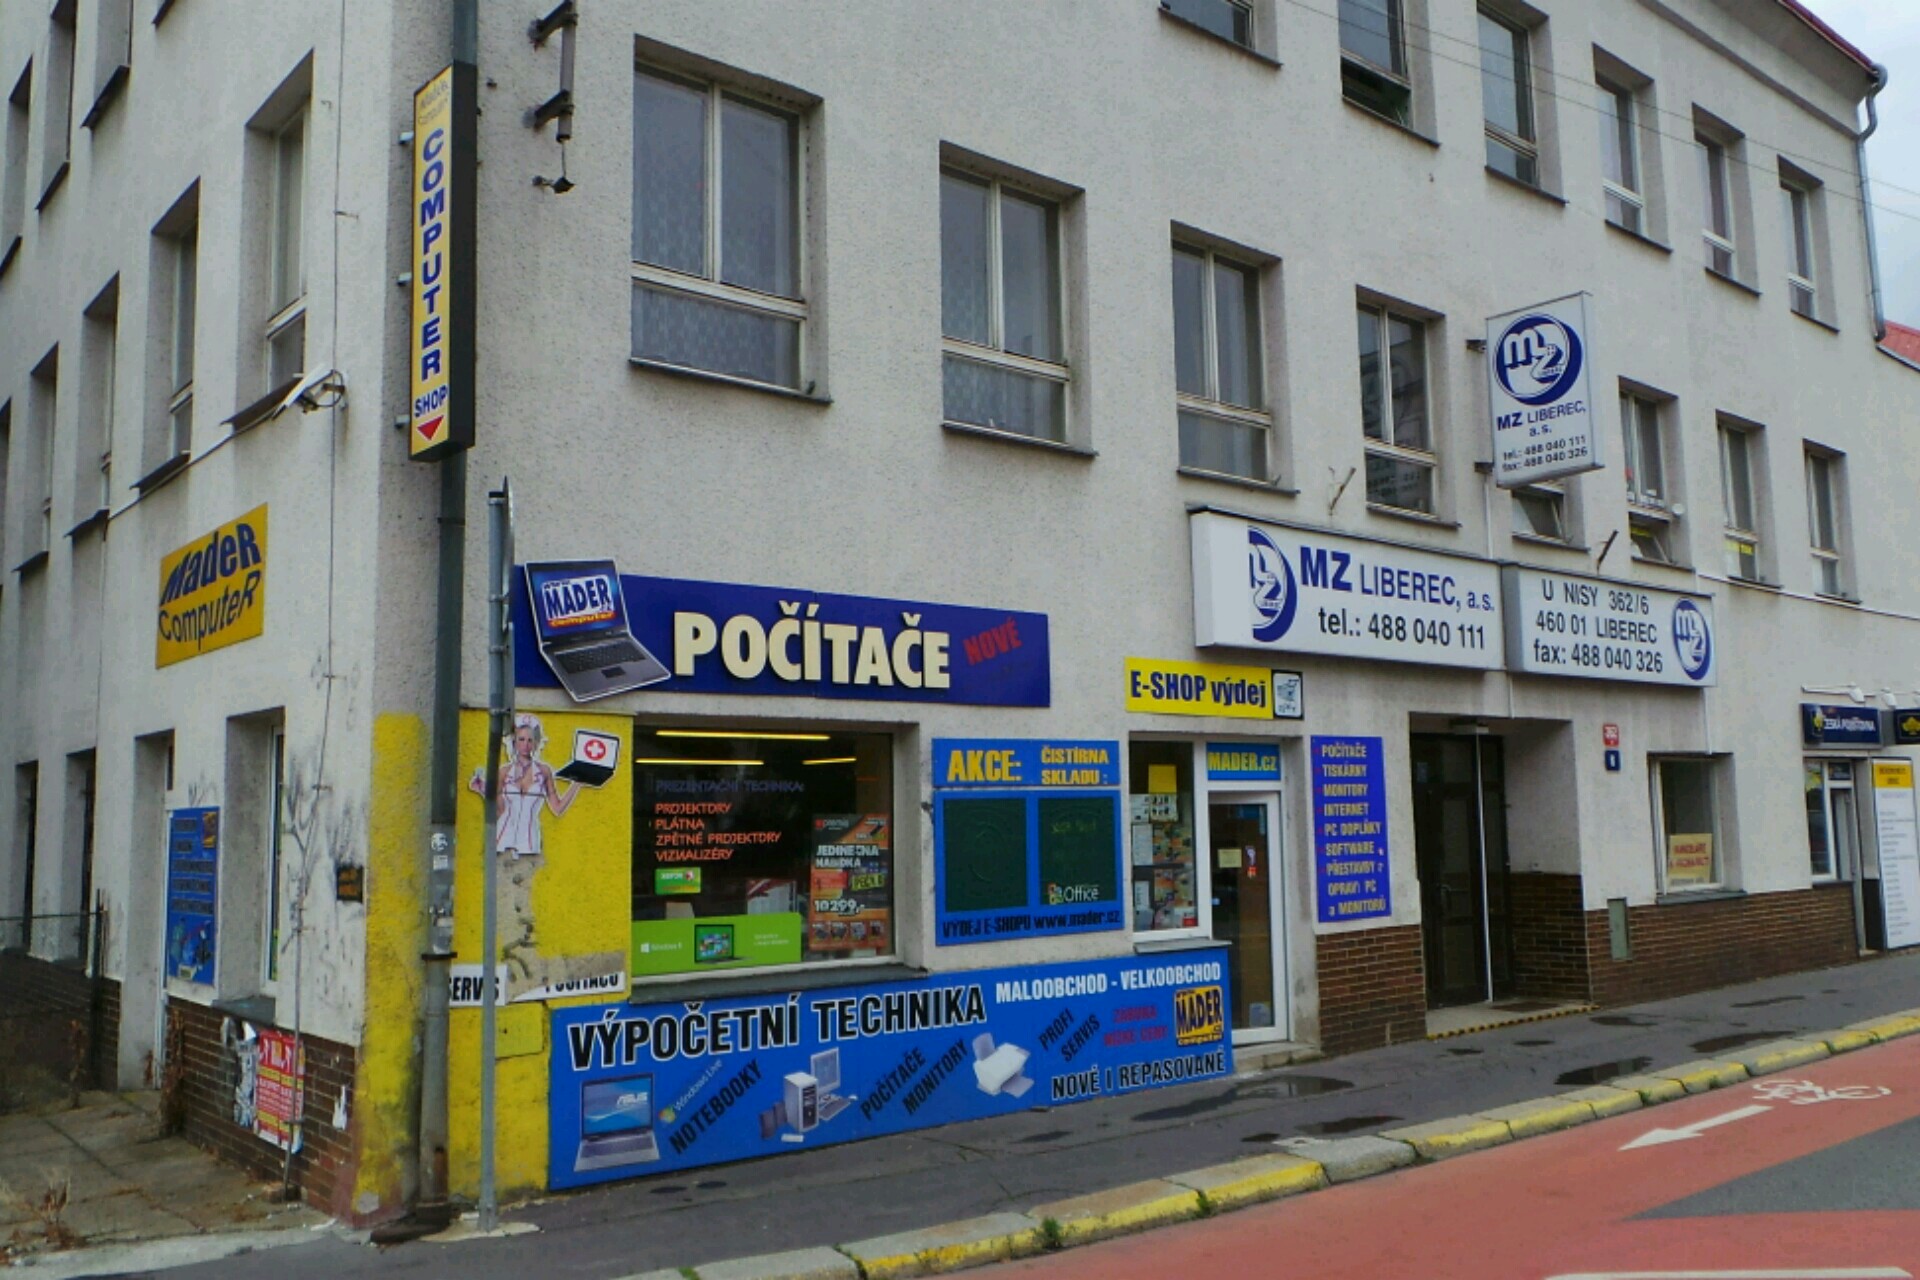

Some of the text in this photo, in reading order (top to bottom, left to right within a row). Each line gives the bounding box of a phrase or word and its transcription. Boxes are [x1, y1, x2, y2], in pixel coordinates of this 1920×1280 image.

[420, 128, 445, 381] COMPUTER
[414, 384, 447, 418] SHOP
[1497, 412, 1522, 431] MZ
[1524, 444, 1543, 456] 488
[1545, 439, 1565, 450] 040
[1569, 435, 1586, 447] 111
[1524, 455, 1543, 468] 488
[1545, 452, 1565, 463] 040
[1568, 447, 1588, 460] 326
[1300, 547, 1353, 593] MZ
[1360, 564, 1462, 613] LIBEREC,
[1542, 579, 1650, 615] U NISY 362/6
[673, 600, 950, 688] POČÍTAČE
[963, 617, 1022, 665] NOVÉ
[1318, 607, 1485, 650] tel.: 488 040 111
[1535, 611, 1657, 644] 460 01 LIBEREC
[1533, 639, 1663, 673] fax: 488 040 326
[1130, 670, 1266, 708] E-SHOP výdej
[1041, 769, 1100, 785] SKLADU
[654, 816, 705, 831] PLÁTNA
[655, 802, 733, 814] PROJEKTORY
[1324, 802, 1369, 816] INTERNET
[707, 831, 781, 844] PROJEKTORY
[995, 972, 1107, 1004] MALOOBCHOD
[1120, 962, 1221, 990] VELKOOBCHOD
[568, 983, 987, 1071] VÝPOČETNÍ TECHNIKA
[1038, 1008, 1075, 1050] PROFI
[1060, 1013, 1101, 1063] SERVIS
[860, 1046, 927, 1121] POČÍTAČE
[903, 1039, 969, 1116] MONITORY
[1052, 1064, 1101, 1100] NOVÉ
[1118, 1044, 1225, 1089] REPASOVANÉ
[668, 1058, 763, 1155] NOTEBOOKY
